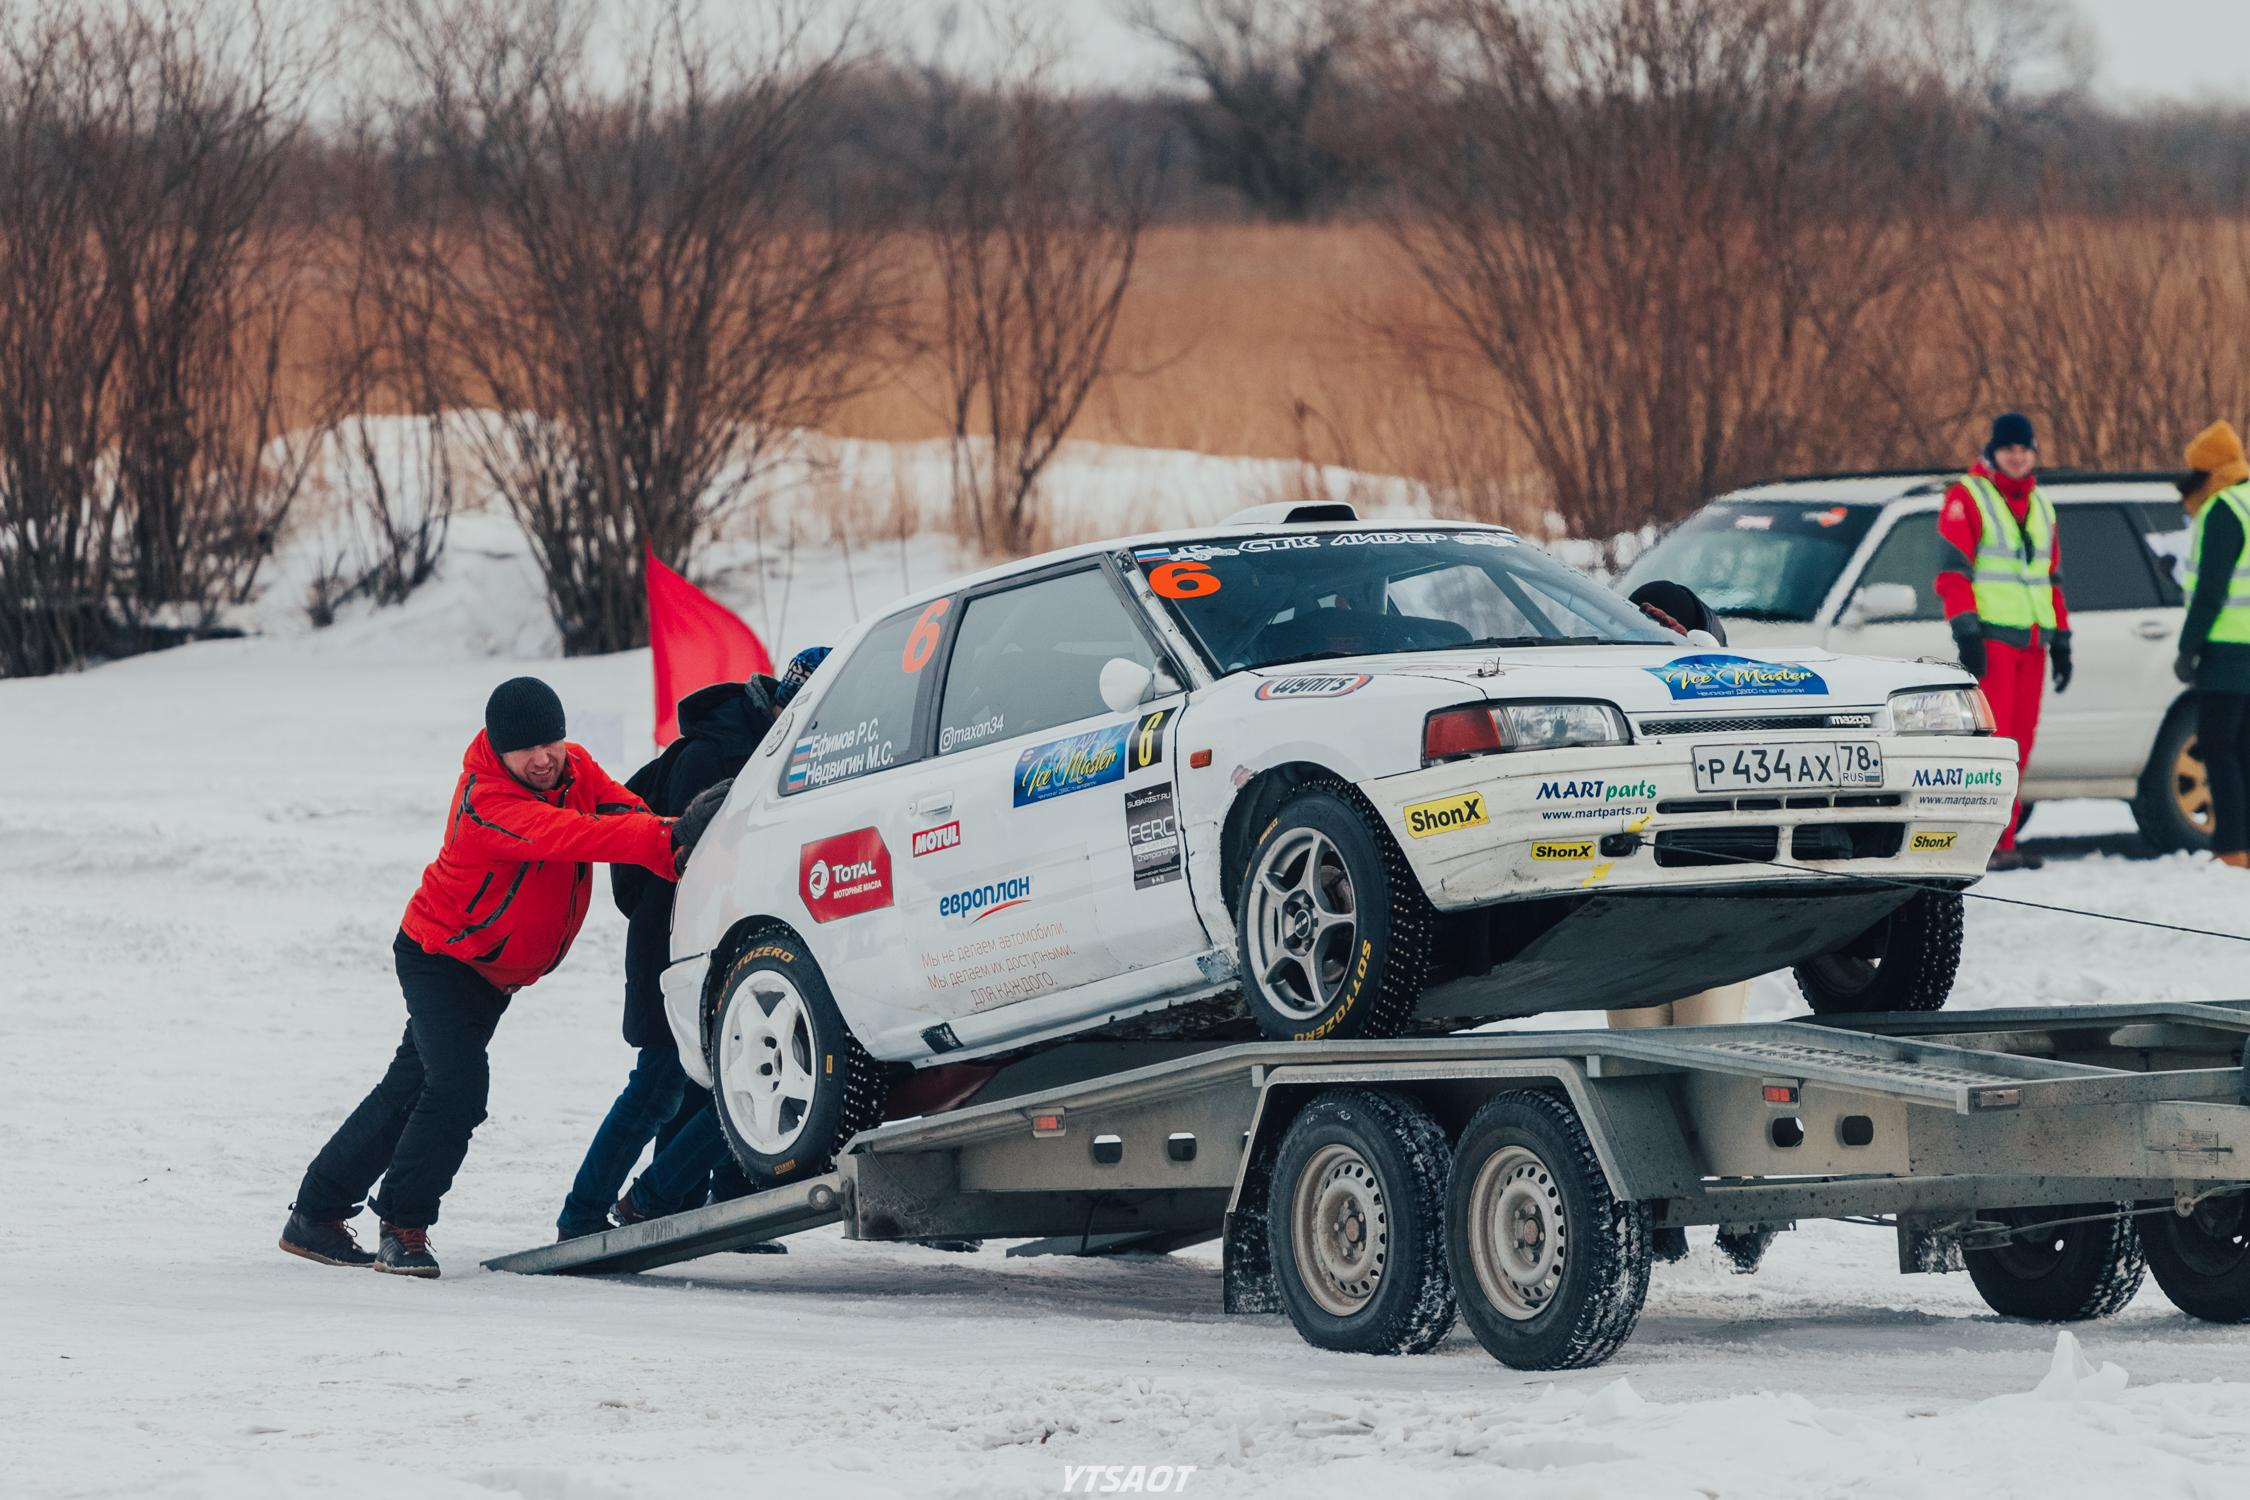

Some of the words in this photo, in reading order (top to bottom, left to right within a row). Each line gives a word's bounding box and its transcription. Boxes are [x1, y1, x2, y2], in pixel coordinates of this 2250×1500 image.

[1239, 536, 1320, 552] СТК
[1330, 533, 1447, 546] ЛИДЕР
[1149, 562, 1221, 599] 6
[903, 598, 950, 673] 6
[1666, 671, 1712, 690] Ice
[1716, 669, 1813, 687] Master
[954, 714, 1004, 744] maxon34
[1832, 715, 1871, 725] mazda
[809, 730, 855, 762] Ефимов
[856, 718, 880, 747] Р.С.
[1138, 711, 1164, 767] 6
[804, 753, 864, 787] Недвигин
[1022, 756, 1053, 798] Ice
[1055, 748, 1117, 787] Master
[1840, 745, 1871, 771] 78
[1842, 772, 1864, 782] RUS
[1411, 799, 1480, 832] ShonX
[1542, 805, 1647, 821] www.martparts.ru
[1920, 795, 1998, 806] www.martparts.ru
[914, 825, 959, 855] MOTUL
[1129, 816, 1175, 845] FERC
[1914, 836, 1957, 847] ShonX
[1535, 845, 1593, 858] ShonX
[832, 860, 877, 883] TOTAL
[833, 884, 863, 899] МОТОРНЫЕ
[863, 879, 882, 892] МАСЛА
[939, 876, 1030, 918] европлан
[921, 952, 939, 969] Мы
[942, 950, 954, 963] не
[958, 938, 996, 961] делаем
[999, 922, 1068, 949] автомобили.
[716, 946, 795, 1012] TOZERO
[927, 974, 948, 991] Мы
[951, 962, 990, 987] делаем
[992, 961, 1003, 975] их
[1007, 943, 1076, 971] доступными.
